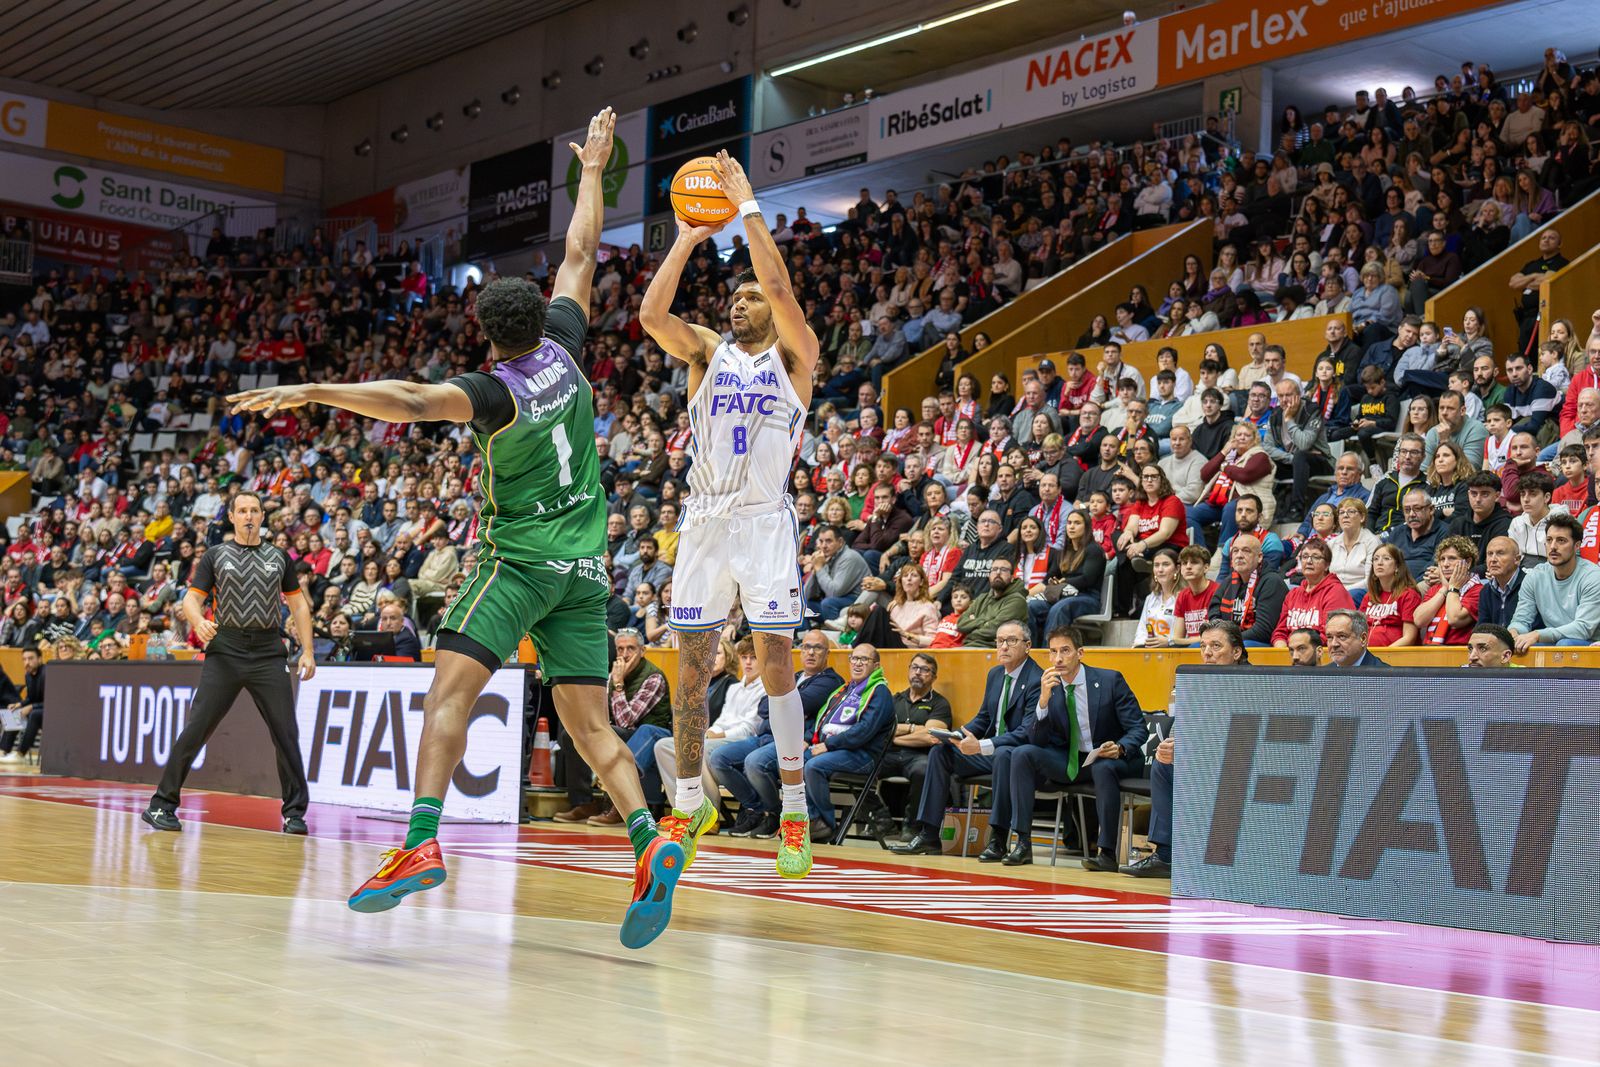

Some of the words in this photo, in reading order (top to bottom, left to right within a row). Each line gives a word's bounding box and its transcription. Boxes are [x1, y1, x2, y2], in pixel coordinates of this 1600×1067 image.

[1339, 7, 1368, 31] que
[1176, 5, 1310, 70] Marlex
[1026, 31, 1135, 92] NACEX
[1062, 91, 1078, 107] by
[1082, 76, 1136, 99] Logista
[675, 99, 736, 133] CaixaBank
[888, 94, 983, 137] RibéSalat
[100, 176, 152, 204] Sant
[496, 179, 549, 215] PACER
[684, 175, 723, 190] Wilso
[551, 422, 573, 487] 1
[732, 425, 747, 456] 8
[672, 606, 703, 620] YOSOY
[99, 685, 132, 763] TU
[307, 689, 510, 798] FIAC
[1204, 713, 1600, 898] FIAT
